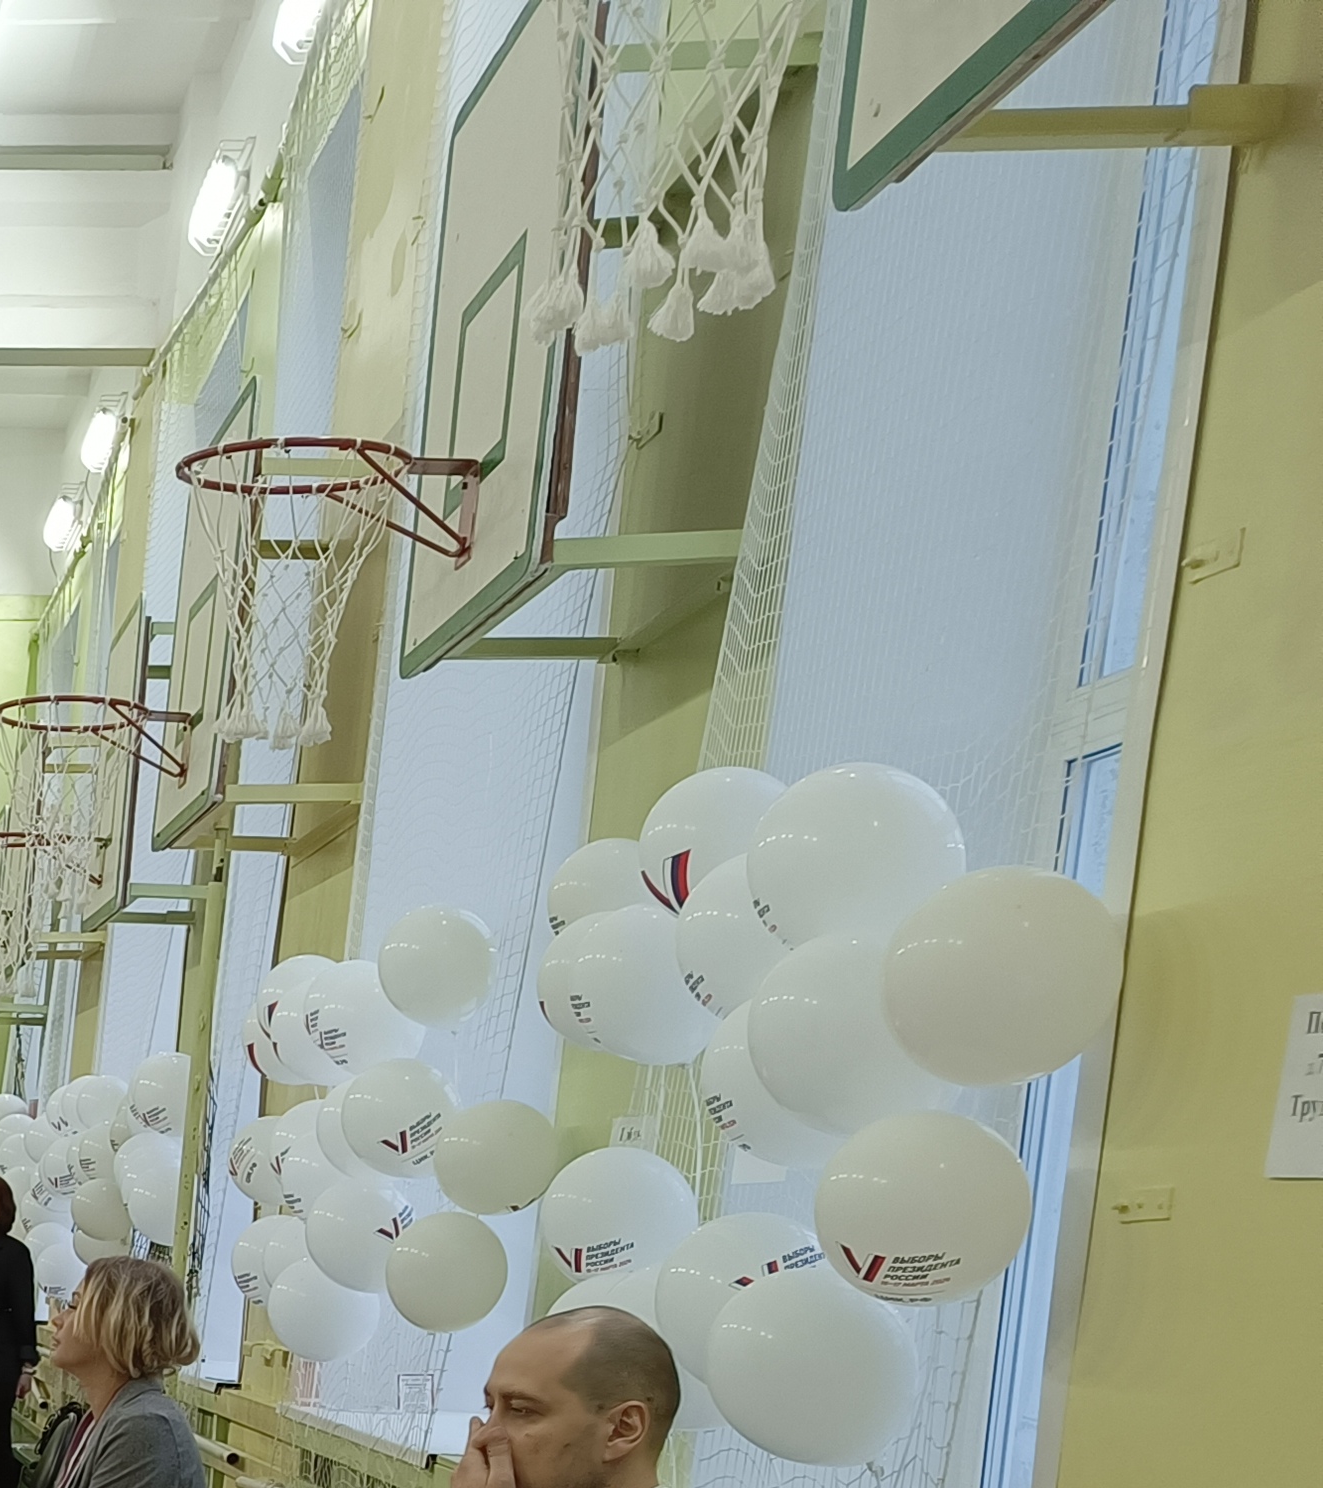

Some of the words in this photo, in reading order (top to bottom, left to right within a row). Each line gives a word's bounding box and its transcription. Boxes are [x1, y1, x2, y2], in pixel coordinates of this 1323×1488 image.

[585, 1241, 634, 1260] ПРЕЗИДЕНТА
[586, 1238, 621, 1253] ВЫБОРЫ
[585, 1257, 614, 1268] РОССИИ
[891, 1252, 947, 1264] ВЫБОРЫ
[887, 1258, 961, 1273] ПРЕЗИДЕНТА
[883, 1273, 930, 1281] РОССИИ
